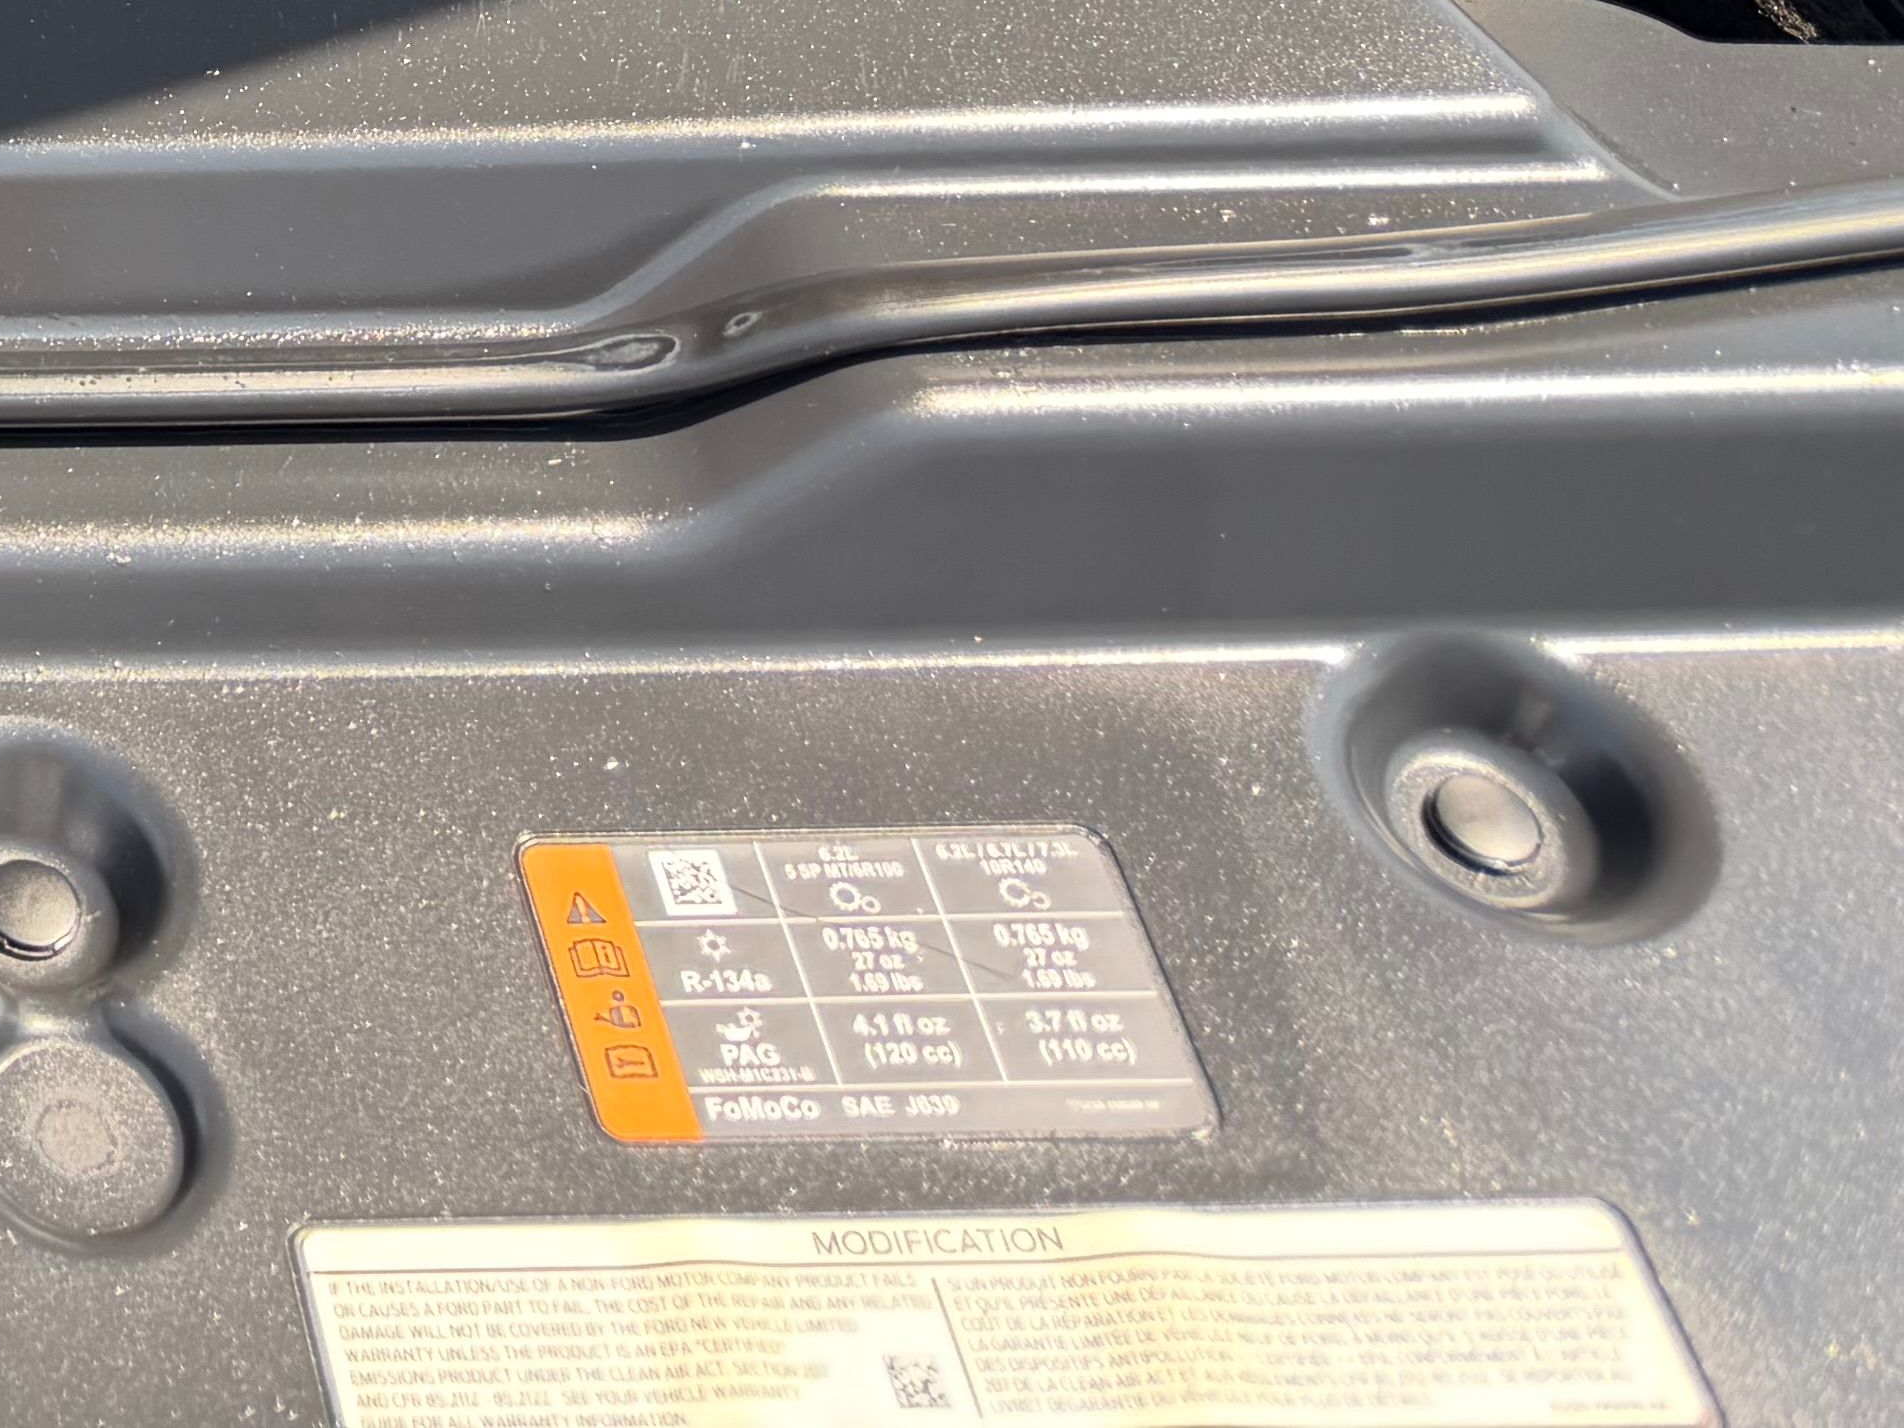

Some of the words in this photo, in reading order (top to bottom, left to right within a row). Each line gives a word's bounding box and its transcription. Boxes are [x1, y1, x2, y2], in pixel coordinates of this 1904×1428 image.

[817, 846, 859, 862] 6.2L
[800, 863, 822, 879] SP
[979, 859, 1047, 876] 10R140
[822, 927, 884, 951] 0.765
[888, 926, 919, 955] kg
[992, 923, 1055, 947] 0.765
[1056, 922, 1090, 951] kg
[851, 951, 875, 971] 27
[879, 955, 906, 970] oz
[1023, 948, 1047, 967] 27
[1051, 951, 1078, 967] oz
[680, 970, 773, 993] R-134a
[848, 973, 892, 993] 1.69
[892, 971, 924, 992] lbs
[1021, 969, 1065, 989] 1.69
[1065, 968, 1096, 988] lbs
[853, 1013, 889, 1036] 4.1
[892, 1012, 914, 1036] fl
[916, 1016, 951, 1036] oz
[1024, 1011, 1061, 1033] 3.7
[1066, 1009, 1088, 1032] fl
[1091, 1013, 1125, 1032] oz
[720, 1043, 782, 1066] PAG
[864, 1042, 917, 1070] (120
[922, 1040, 962, 1069] cc)
[1038, 1038, 1093, 1067] (110
[1096, 1037, 1138, 1066] cc)
[704, 1095, 821, 1121] FoMoCo
[841, 1095, 895, 1117] SAE
[812, 1226, 1064, 1255] MODIFICATION
[329, 1281, 339, 1296] IF
[347, 1280, 375, 1296] THE
[380, 1278, 529, 1295] INSTALLATION/USE
[532, 1278, 551, 1292] OF
[557, 1277, 568, 1292] A
[571, 1274, 653, 1292] NON-FORD
[657, 1272, 714, 1289] MOTOR
[717, 1271, 790, 1288] COMPANY
[794, 1272, 867, 1289] PRODUCT
[872, 1272, 917, 1288] FAILS
[1060, 1274, 1096, 1290] NON
[333, 1302, 356, 1319] OR
[358, 1302, 420, 1318] CAUSES
[423, 1302, 435, 1317] A
[437, 1301, 479, 1317] FORD
[482, 1300, 522, 1317] PART
[528, 1300, 549, 1314] TO
[593, 1298, 622, 1314] THE
[627, 1295, 668, 1314] COST
[672, 1294, 690, 1310] OF
[698, 1293, 725, 1308] THE
[730, 1293, 785, 1310] REPAIR
[789, 1295, 823, 1310] AND
[825, 1294, 857, 1310] ANY
[860, 1293, 933, 1310] RELATED
[1103, 1290, 1134, 1308] UNE
[339, 1324, 404, 1341] DAMAGE
[408, 1324, 447, 1340] WILL
[449, 1324, 481, 1340] NOT
[485, 1323, 504, 1339] BE
[508, 1322, 582, 1339] COVERED
[585, 1323, 605, 1338] BY
[610, 1319, 640, 1336] THE
[644, 1317, 689, 1335] FORD
[689, 1315, 727, 1332] NEW
[731, 1316, 793, 1334] VEHICLE
[797, 1317, 860, 1334] LIMITED
[344, 1346, 433, 1363] WARRANTY
[438, 1345, 501, 1362] UNLESS
[504, 1344, 531, 1361] THE
[537, 1342, 610, 1360] PRODUCT
[616, 1342, 632, 1359] IS
[635, 1341, 655, 1358] AN
[659, 1340, 693, 1357] EPA
[350, 1369, 435, 1386] EMISSIONS
[438, 1368, 511, 1385] PRODUCT
[517, 1366, 571, 1384] UNDER
[576, 1366, 608, 1383] THE
[609, 1363, 659, 1382] CLEAN
[664, 1362, 690, 1380] AIR
[732, 1360, 798, 1377] SECTION
[356, 1392, 388, 1409] AND
[560, 1388, 590, 1405] SEE
[594, 1388, 639, 1406] YOUR
[641, 1384, 708, 1404] VEHICLE
[712, 1384, 802, 1399] WARRANTY
[448, 1413, 471, 1428] ALL
[479, 1413, 569, 1427] WARRANTY
